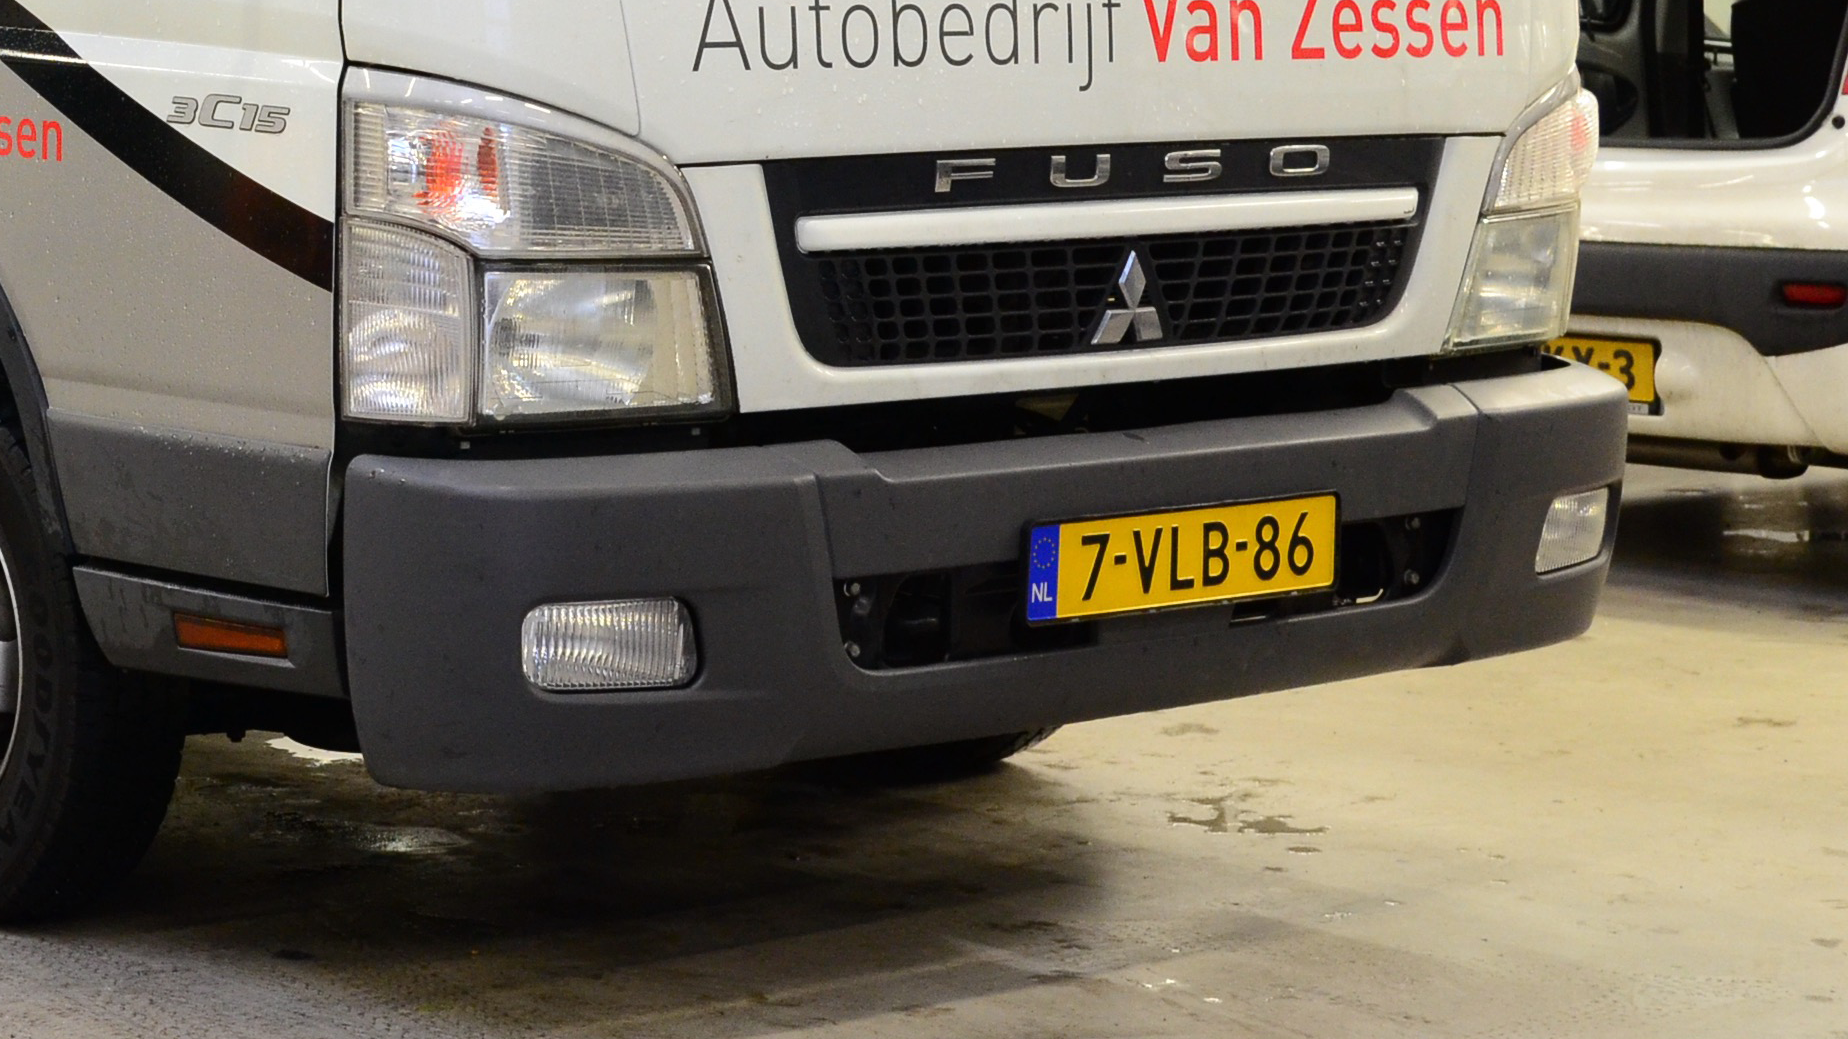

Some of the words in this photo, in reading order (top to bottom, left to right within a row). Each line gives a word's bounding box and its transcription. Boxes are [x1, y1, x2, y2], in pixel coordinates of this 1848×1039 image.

[166, 93, 291, 134] 3C15
[934, 144, 1331, 193] FUSO
[1081, 512, 1315, 601] 7-VLB-86
[1032, 582, 1052, 604] NL
